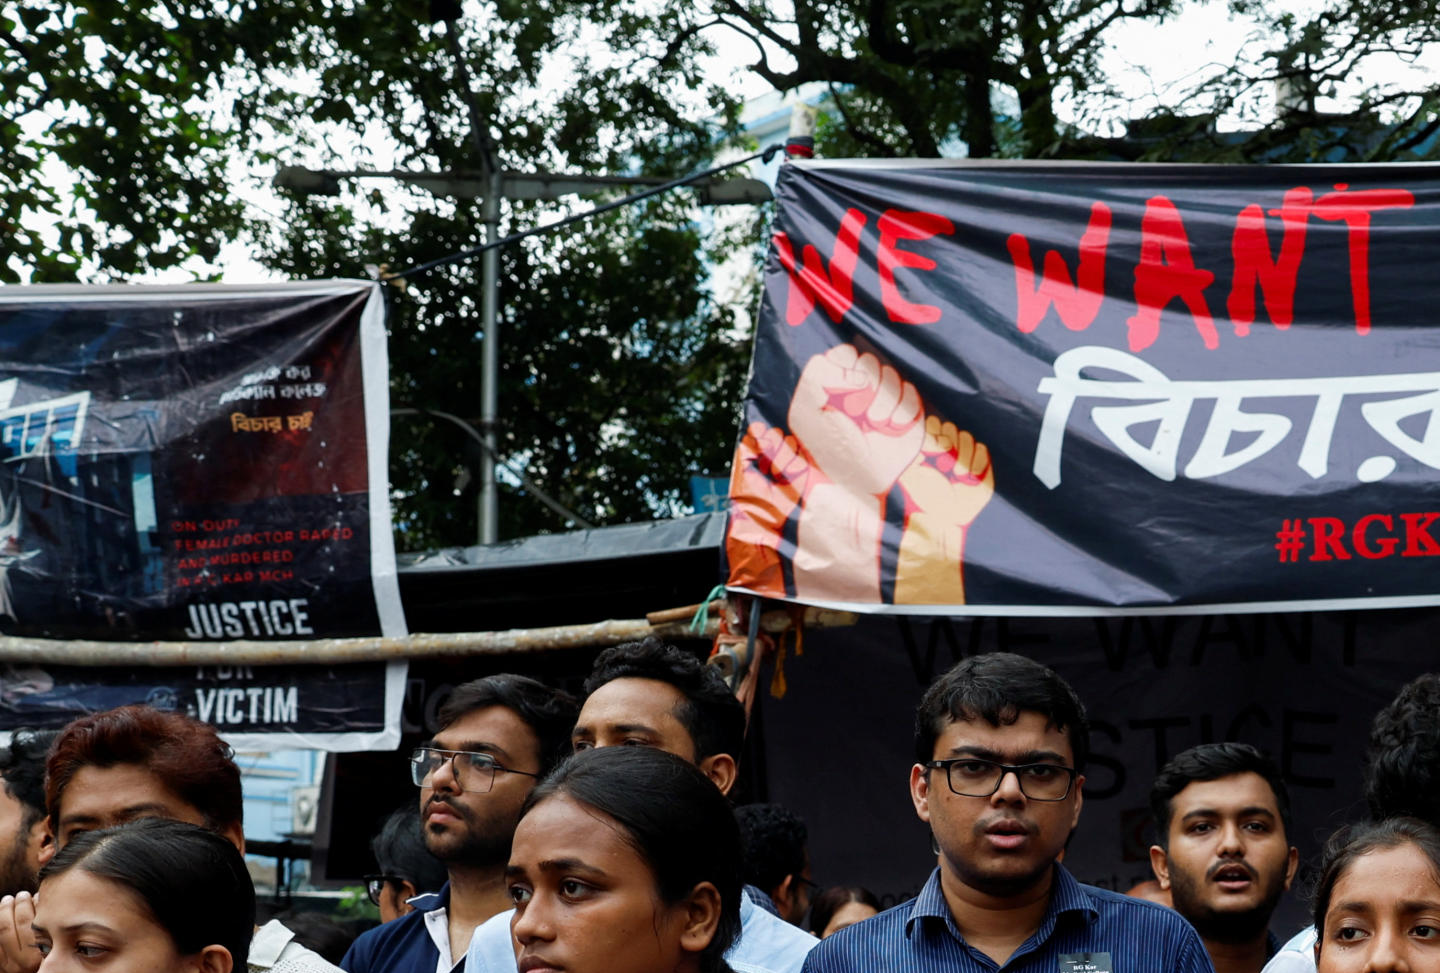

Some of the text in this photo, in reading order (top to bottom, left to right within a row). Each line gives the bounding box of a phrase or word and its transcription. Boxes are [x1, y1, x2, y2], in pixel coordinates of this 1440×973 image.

[771, 208, 955, 327] WE
[1006, 184, 1415, 351] WANT
[184, 598, 314, 639] JUSTICE
[195, 686, 298, 724] VICTIM
